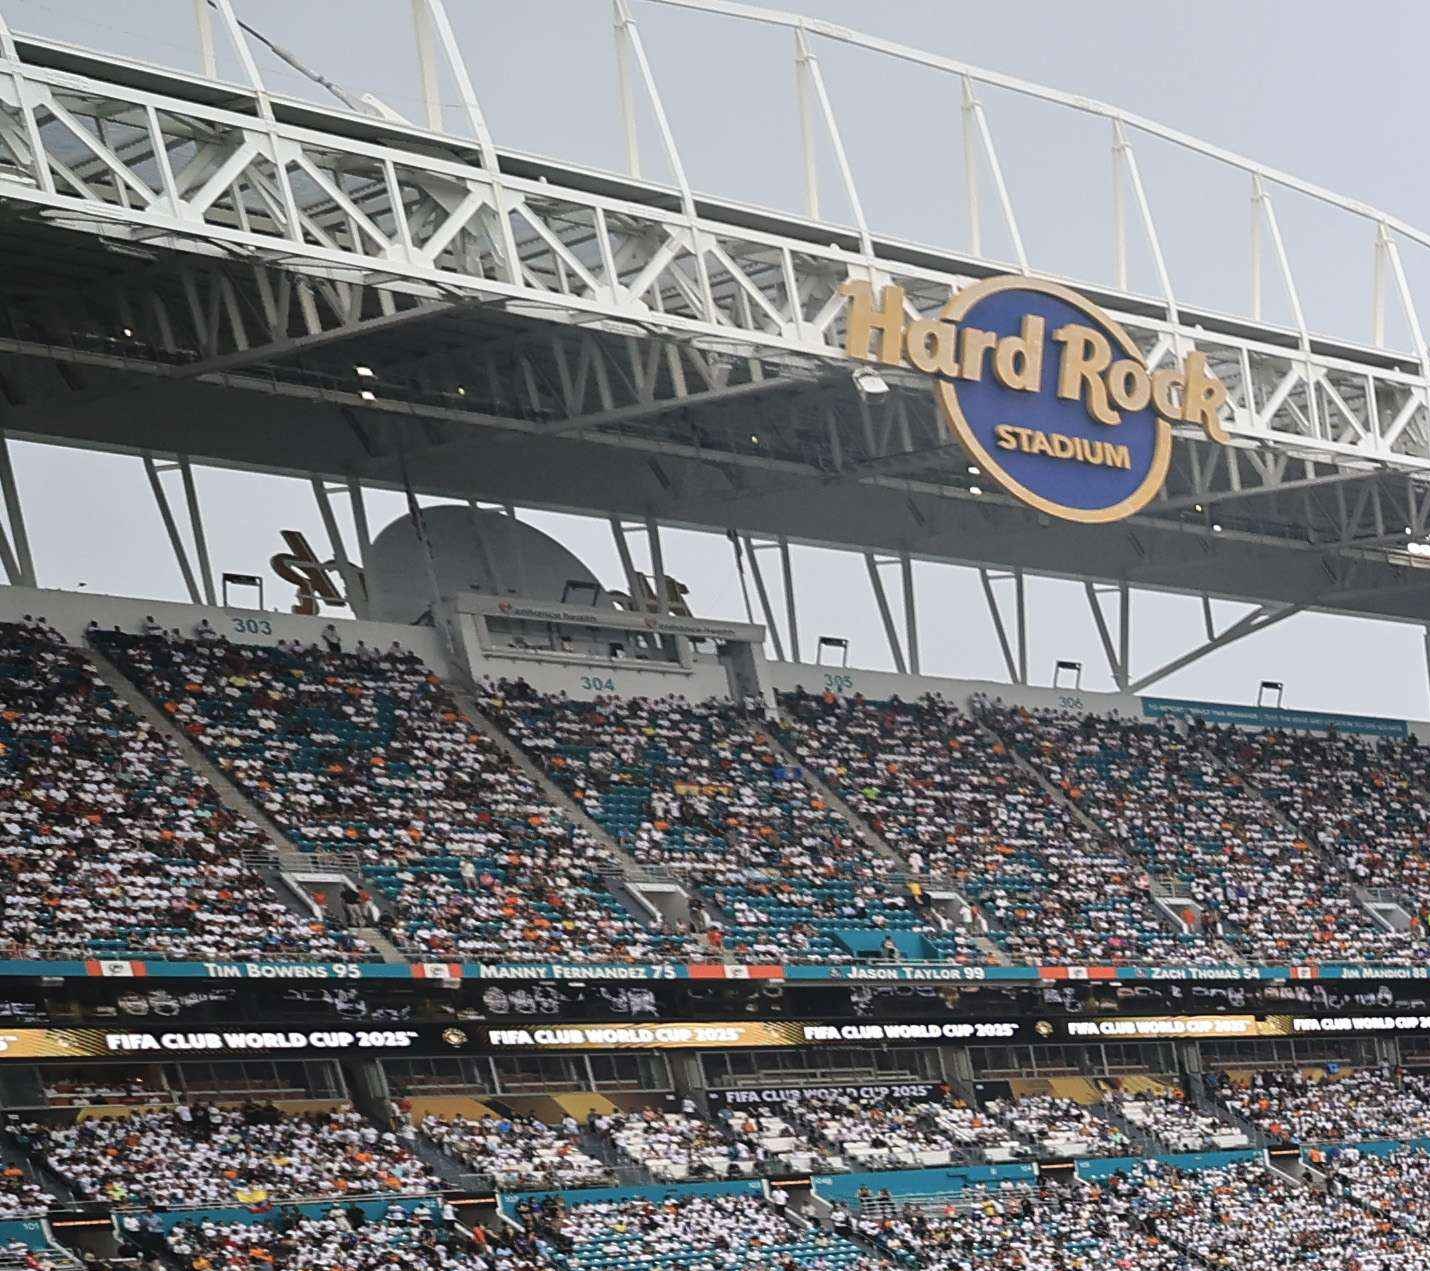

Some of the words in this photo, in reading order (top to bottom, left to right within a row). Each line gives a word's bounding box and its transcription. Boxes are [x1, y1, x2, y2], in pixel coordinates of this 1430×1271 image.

[841, 280, 1046, 393] Hard
[1052, 323, 1231, 446] Rock
[994, 423, 1132, 471] STADIUM
[232, 618, 272, 636] 303
[580, 675, 616, 692] 304
[204, 963, 241, 977] TIM
[247, 963, 329, 978] BOWENS
[332, 963, 361, 978] 95
[480, 965, 546, 979] MANNY
[553, 965, 647, 979] FERNANDEZ
[652, 965, 677, 979] 75
[848, 966, 897, 980] JASON
[902, 966, 960, 980] TAYLOR
[964, 966, 984, 980] 99
[1150, 967, 1185, 979] ZACH
[1190, 967, 1241, 979] THOMAS
[1243, 967, 1260, 979] 54
[804, 1025, 841, 1040] FIFA
[841, 1025, 883, 1039] CLUB
[883, 1024, 942, 1039] WORLD
[942, 1023, 974, 1038] CUP
[106, 1033, 161, 1050] FIFA
[161, 1033, 222, 1050] CLUB
[223, 1032, 308, 1049] WORLD
[309, 1031, 354, 1048] CUP
